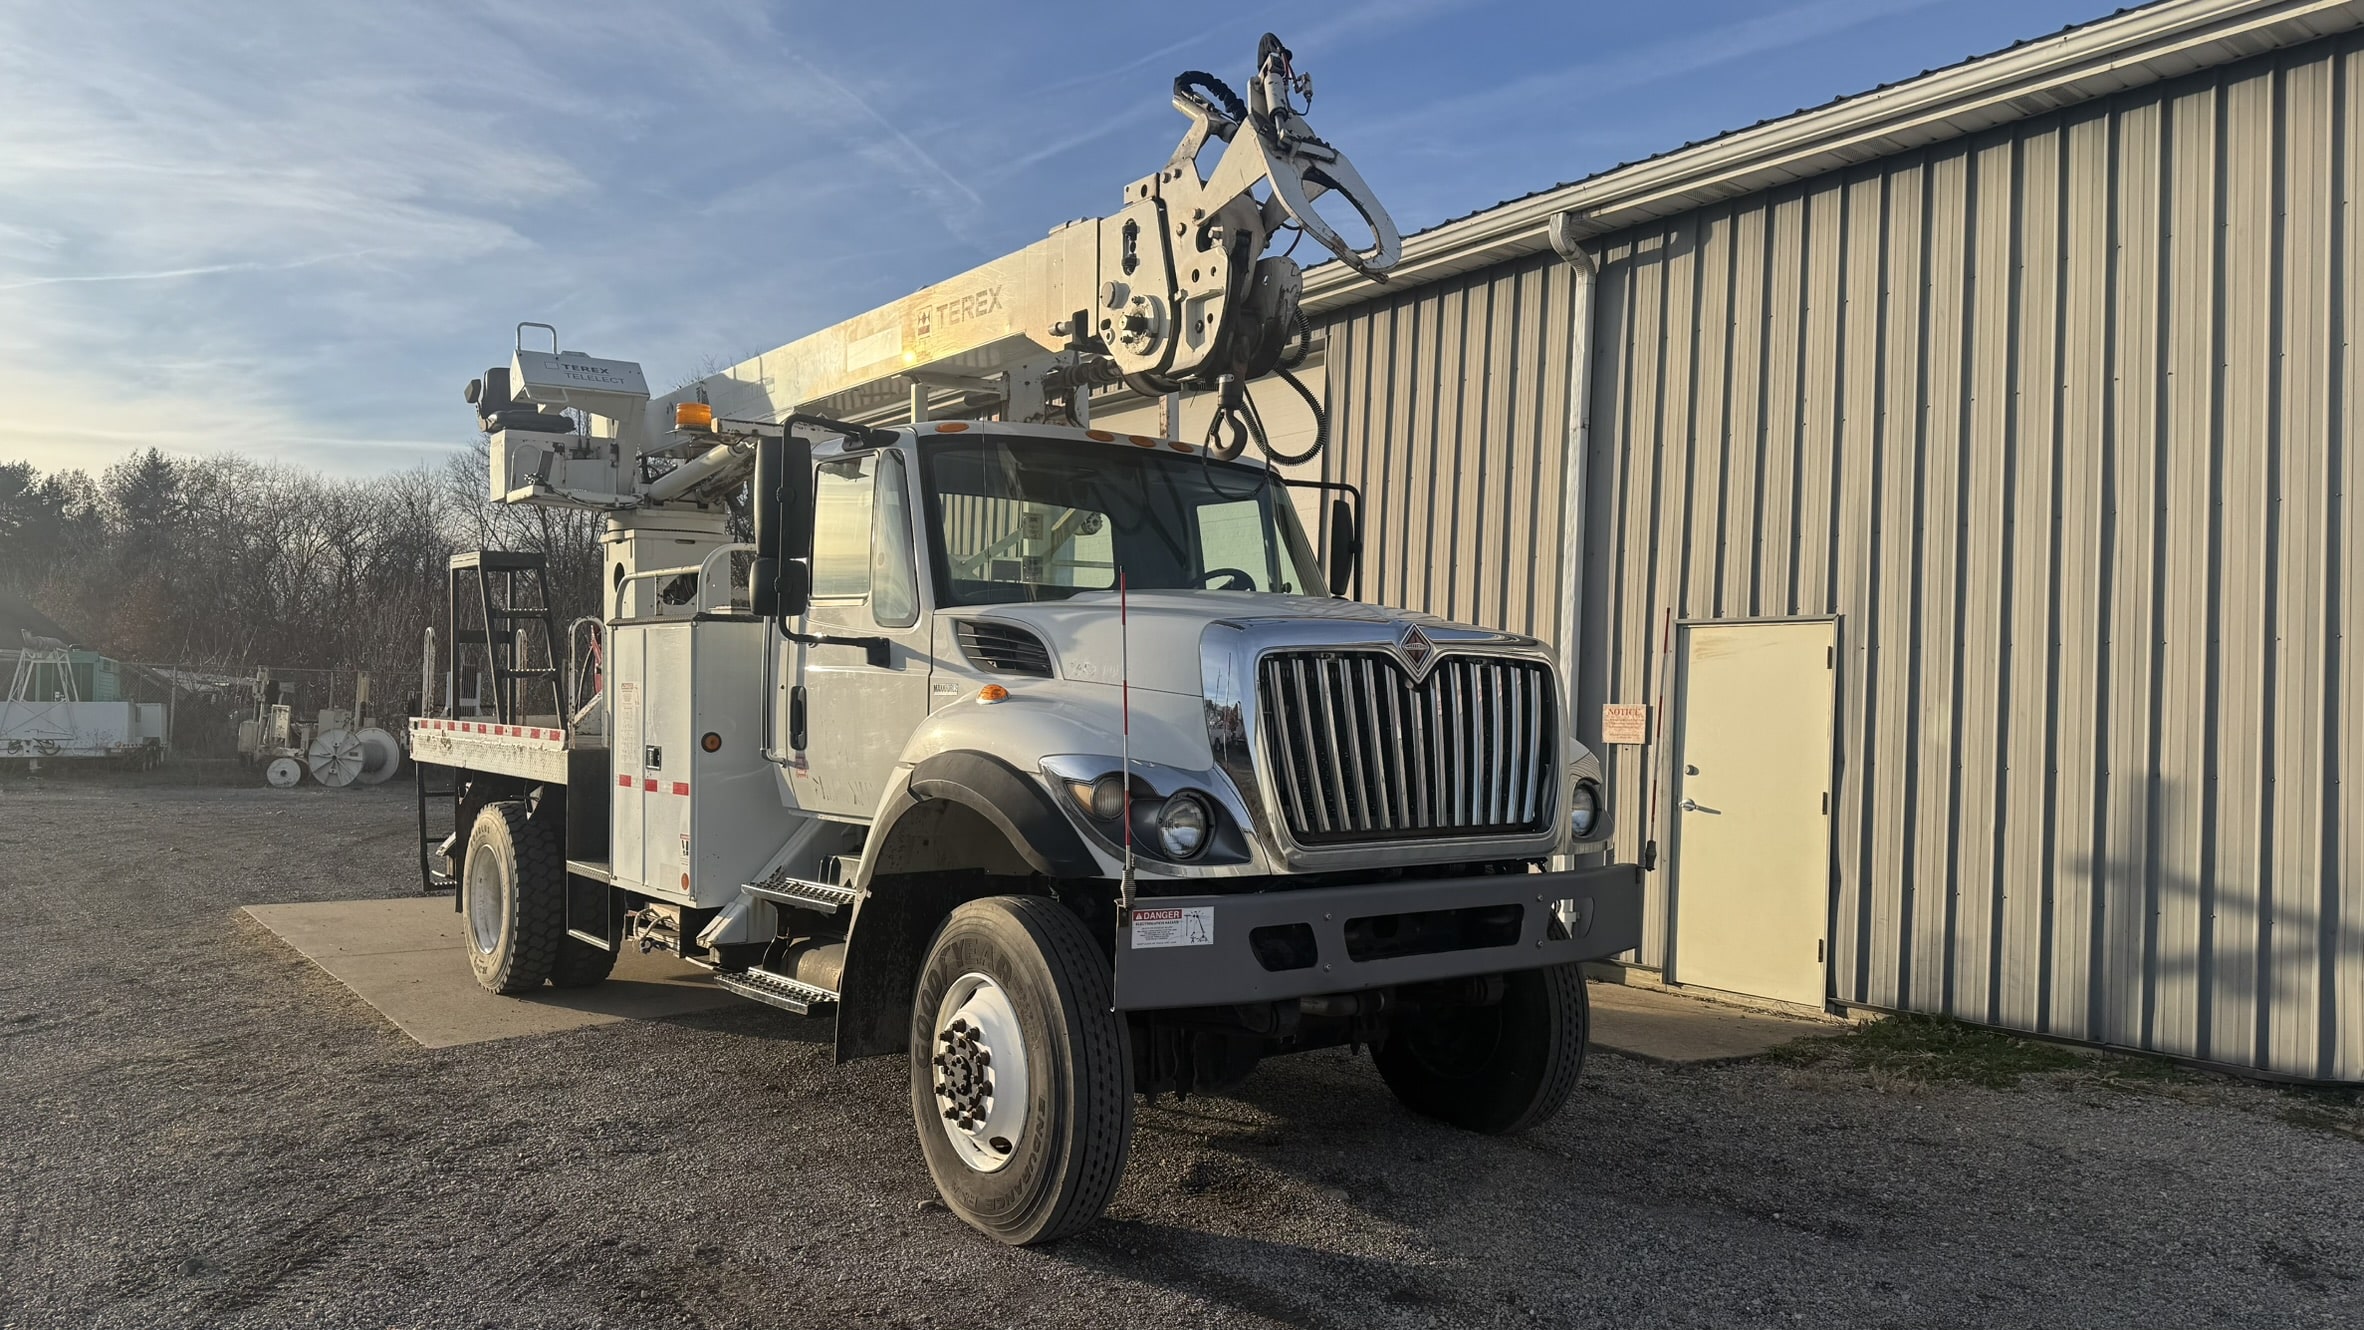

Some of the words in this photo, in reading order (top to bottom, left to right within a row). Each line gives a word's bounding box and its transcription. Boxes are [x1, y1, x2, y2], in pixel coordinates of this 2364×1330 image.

[936, 284, 1003, 329] TEREX
[561, 363, 609, 374] TEREX
[565, 373, 625, 384] TELELECT
[1608, 708, 1641, 716] NOTICE
[1143, 910, 1180, 920] DANGER
[914, 937, 1013, 1069] GOODYEAR
[983, 1096, 1046, 1211] ENDURANCE
